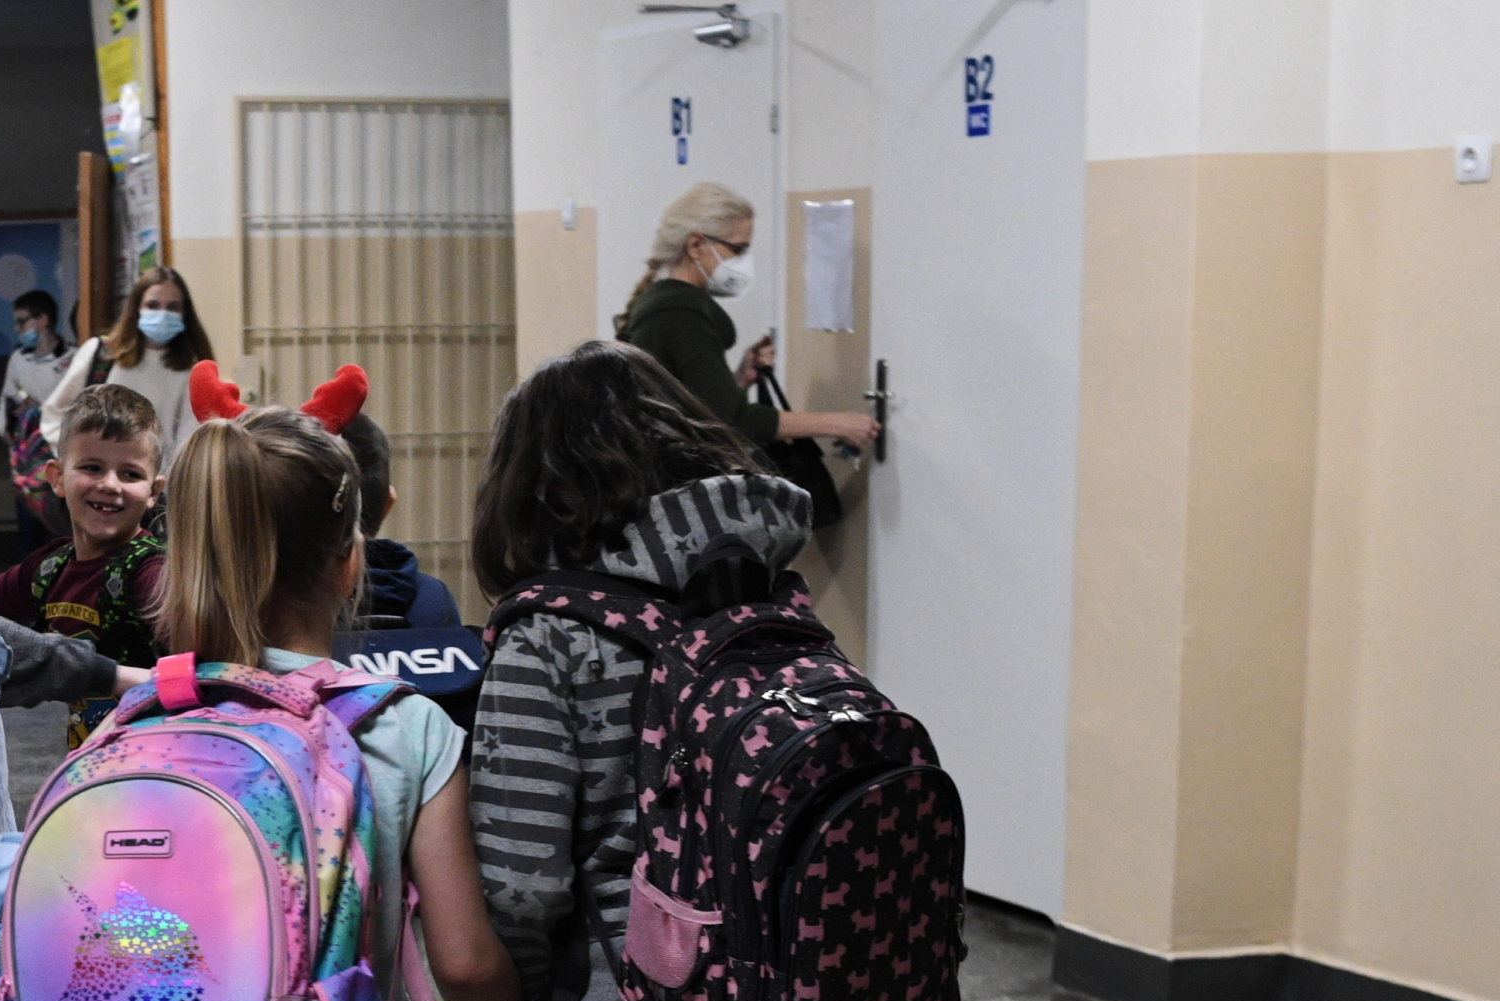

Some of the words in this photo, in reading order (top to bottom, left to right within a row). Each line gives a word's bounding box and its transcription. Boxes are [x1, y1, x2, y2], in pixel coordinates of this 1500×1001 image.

[965, 55, 994, 102] B2
[671, 97, 691, 136] B1
[349, 647, 480, 676] NASA
[110, 838, 165, 848] HEAD
